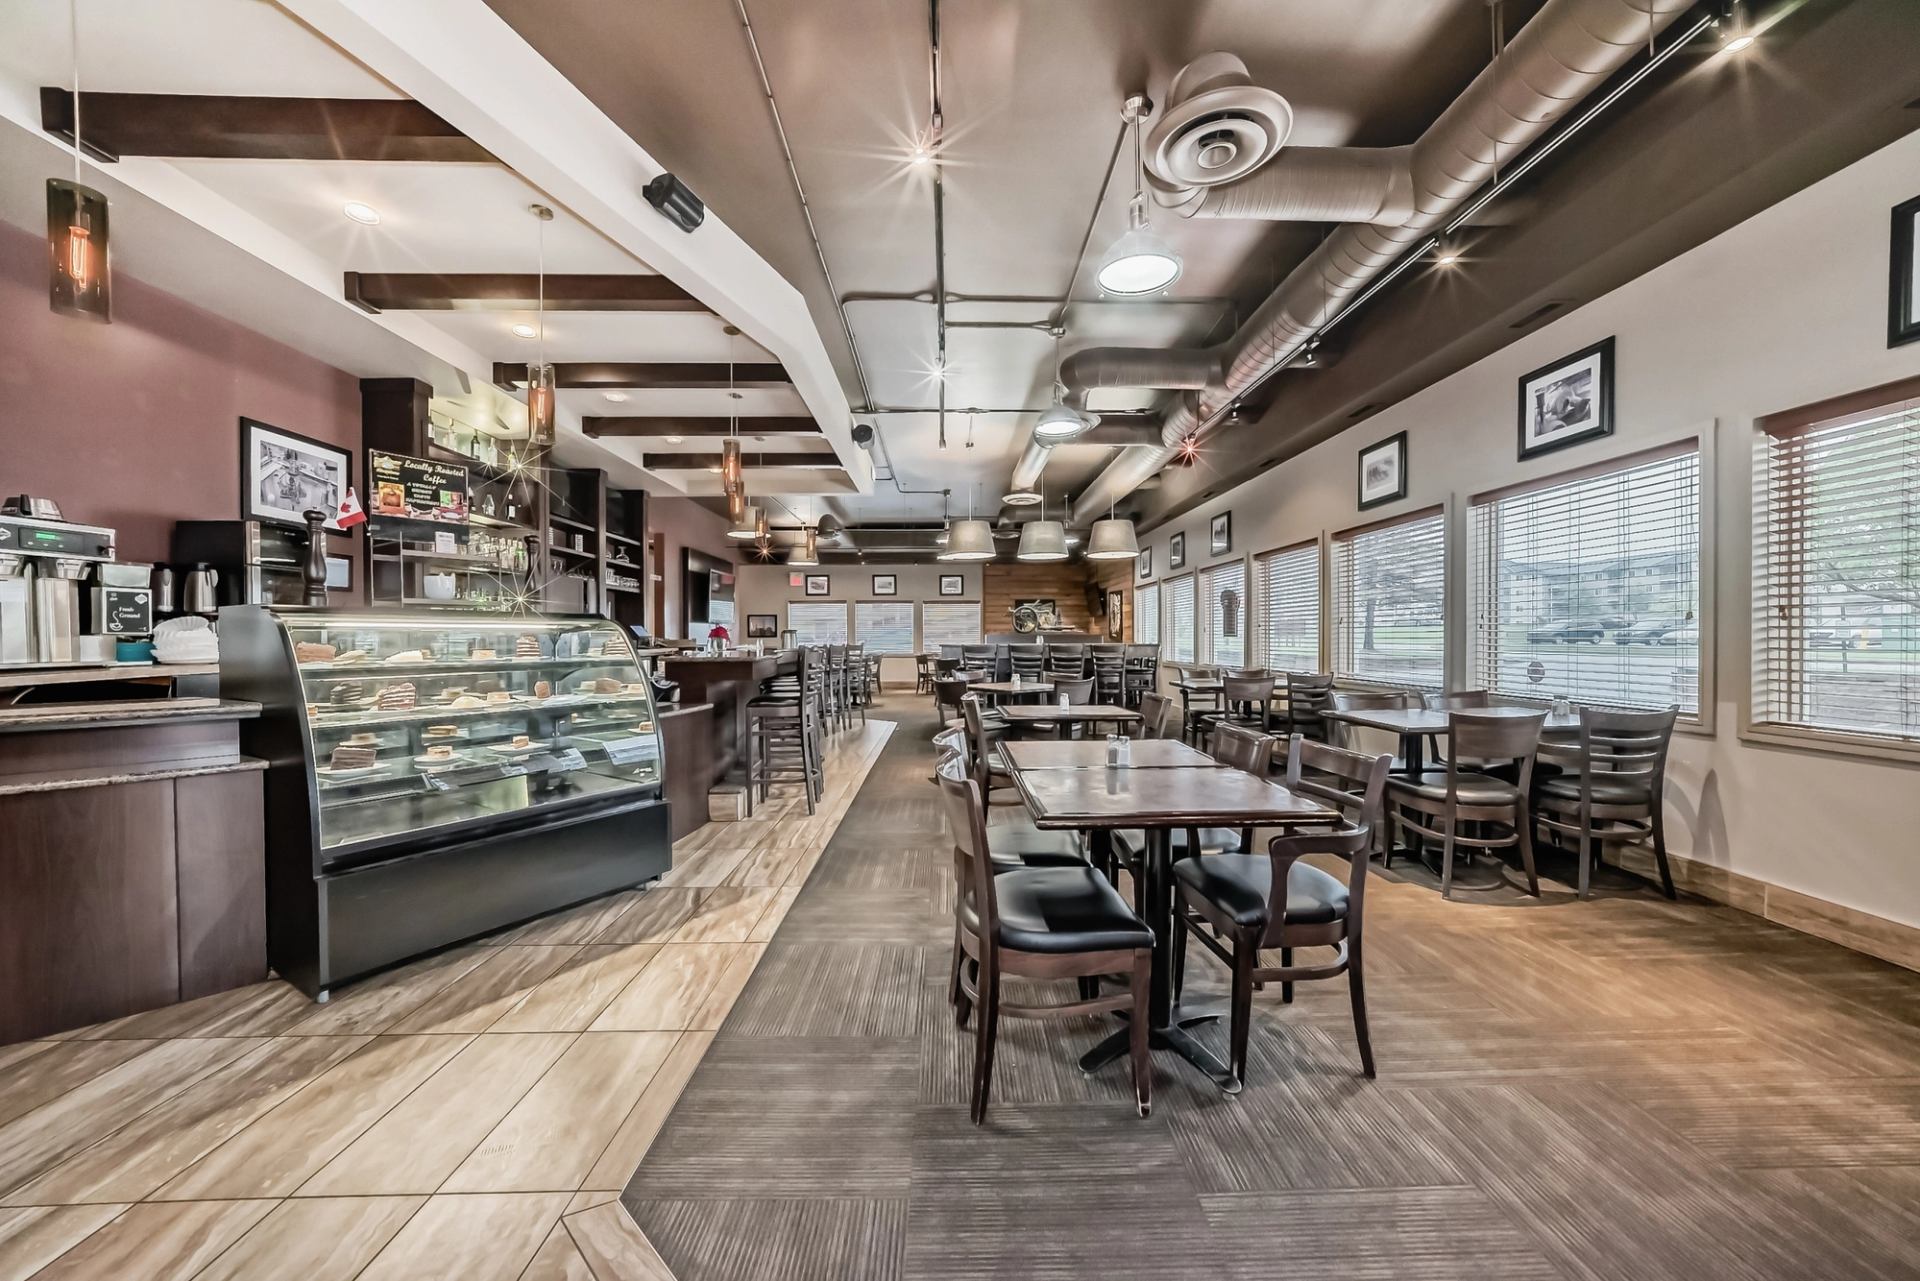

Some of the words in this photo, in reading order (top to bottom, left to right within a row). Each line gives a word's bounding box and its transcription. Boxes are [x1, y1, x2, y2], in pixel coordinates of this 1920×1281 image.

[404, 460, 433, 473] Locally
[435, 465, 464, 477] Roasted
[423, 473, 447, 484] Coffee
